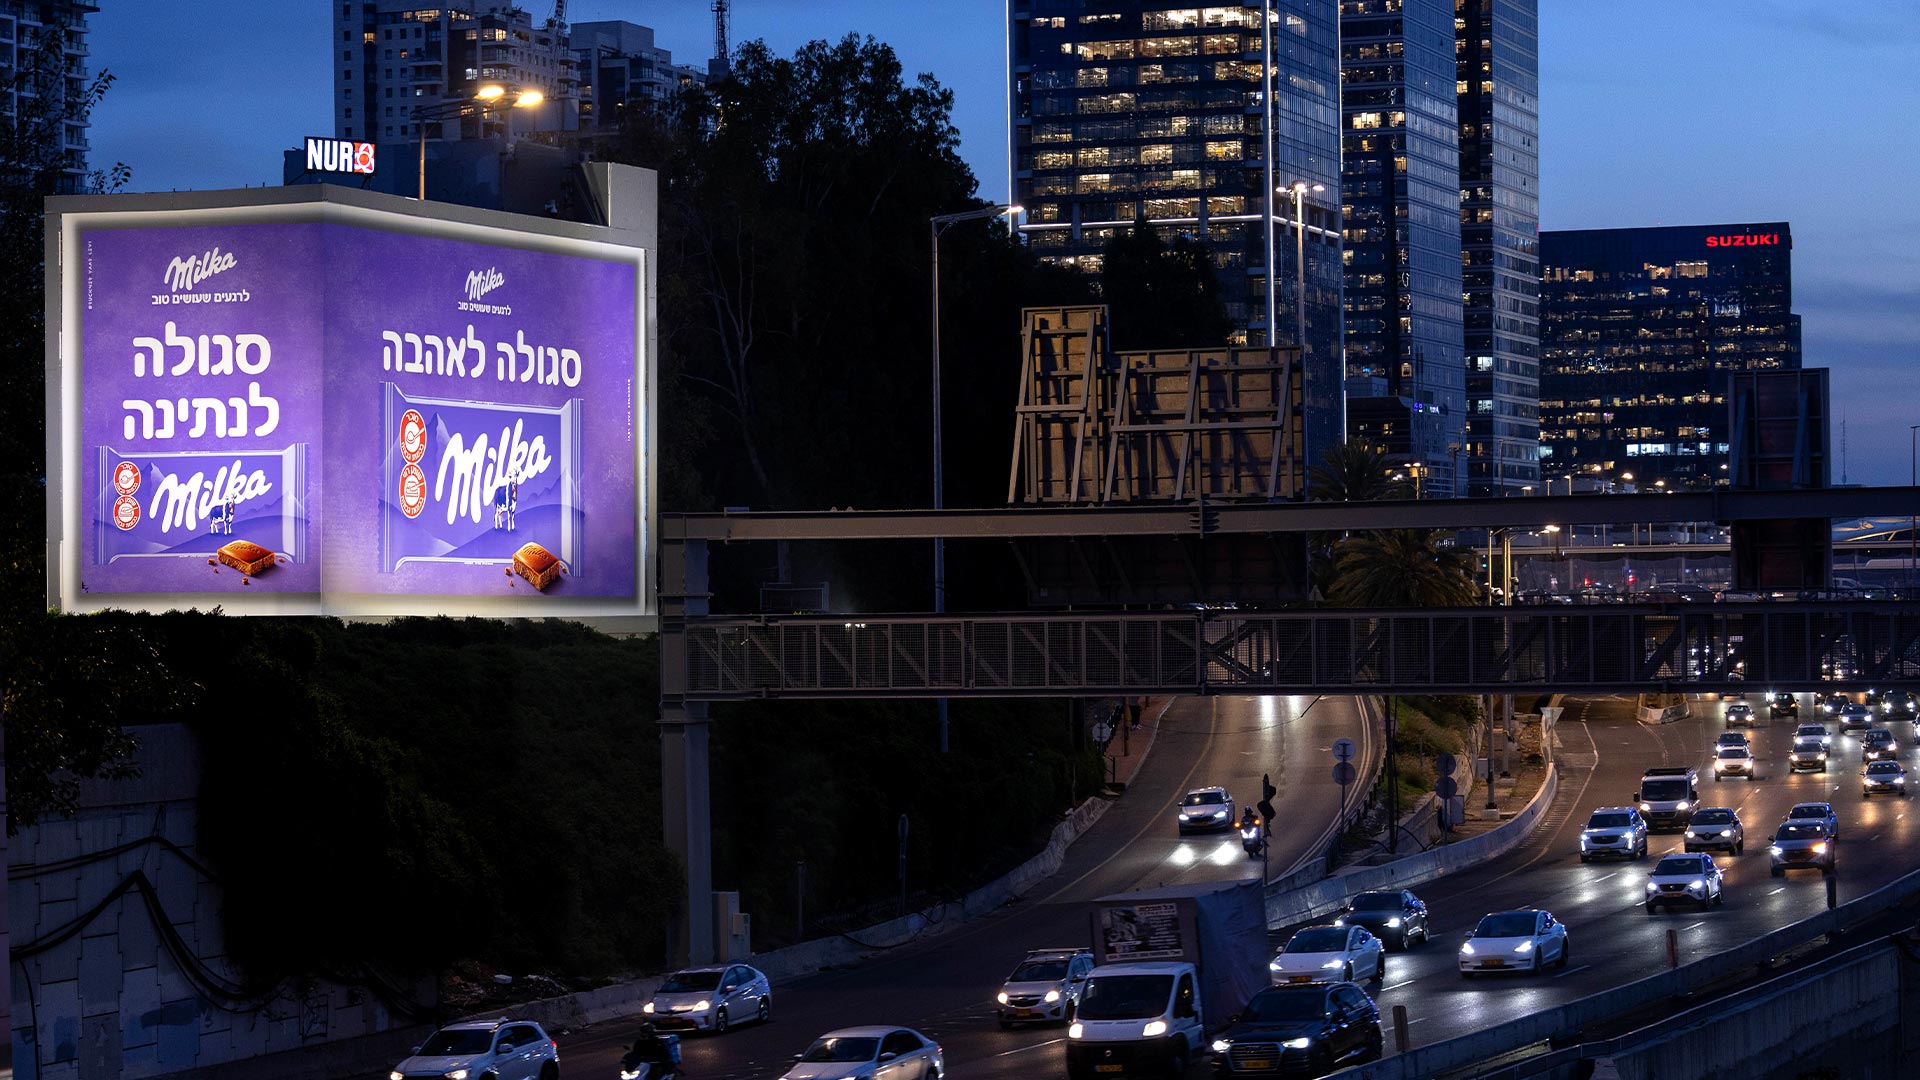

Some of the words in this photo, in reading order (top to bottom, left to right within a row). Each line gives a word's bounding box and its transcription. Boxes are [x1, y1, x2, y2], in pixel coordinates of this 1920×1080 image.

[307, 138, 354, 173] NUR
[1706, 233, 1779, 247] SUZUKI
[164, 247, 237, 293] Milka
[465, 266, 505, 301] Milka
[151, 294, 170, 305] טוב
[172, 292, 211, 304] שעושים
[213, 288, 250, 303] לרגעים
[132, 321, 271, 378] סגולה
[382, 324, 486, 379] לאהבה
[496, 329, 582, 388] סגולה
[122, 381, 280, 440] לנתינה
[435, 417, 552, 526] Milka
[149, 459, 273, 534] Milka
